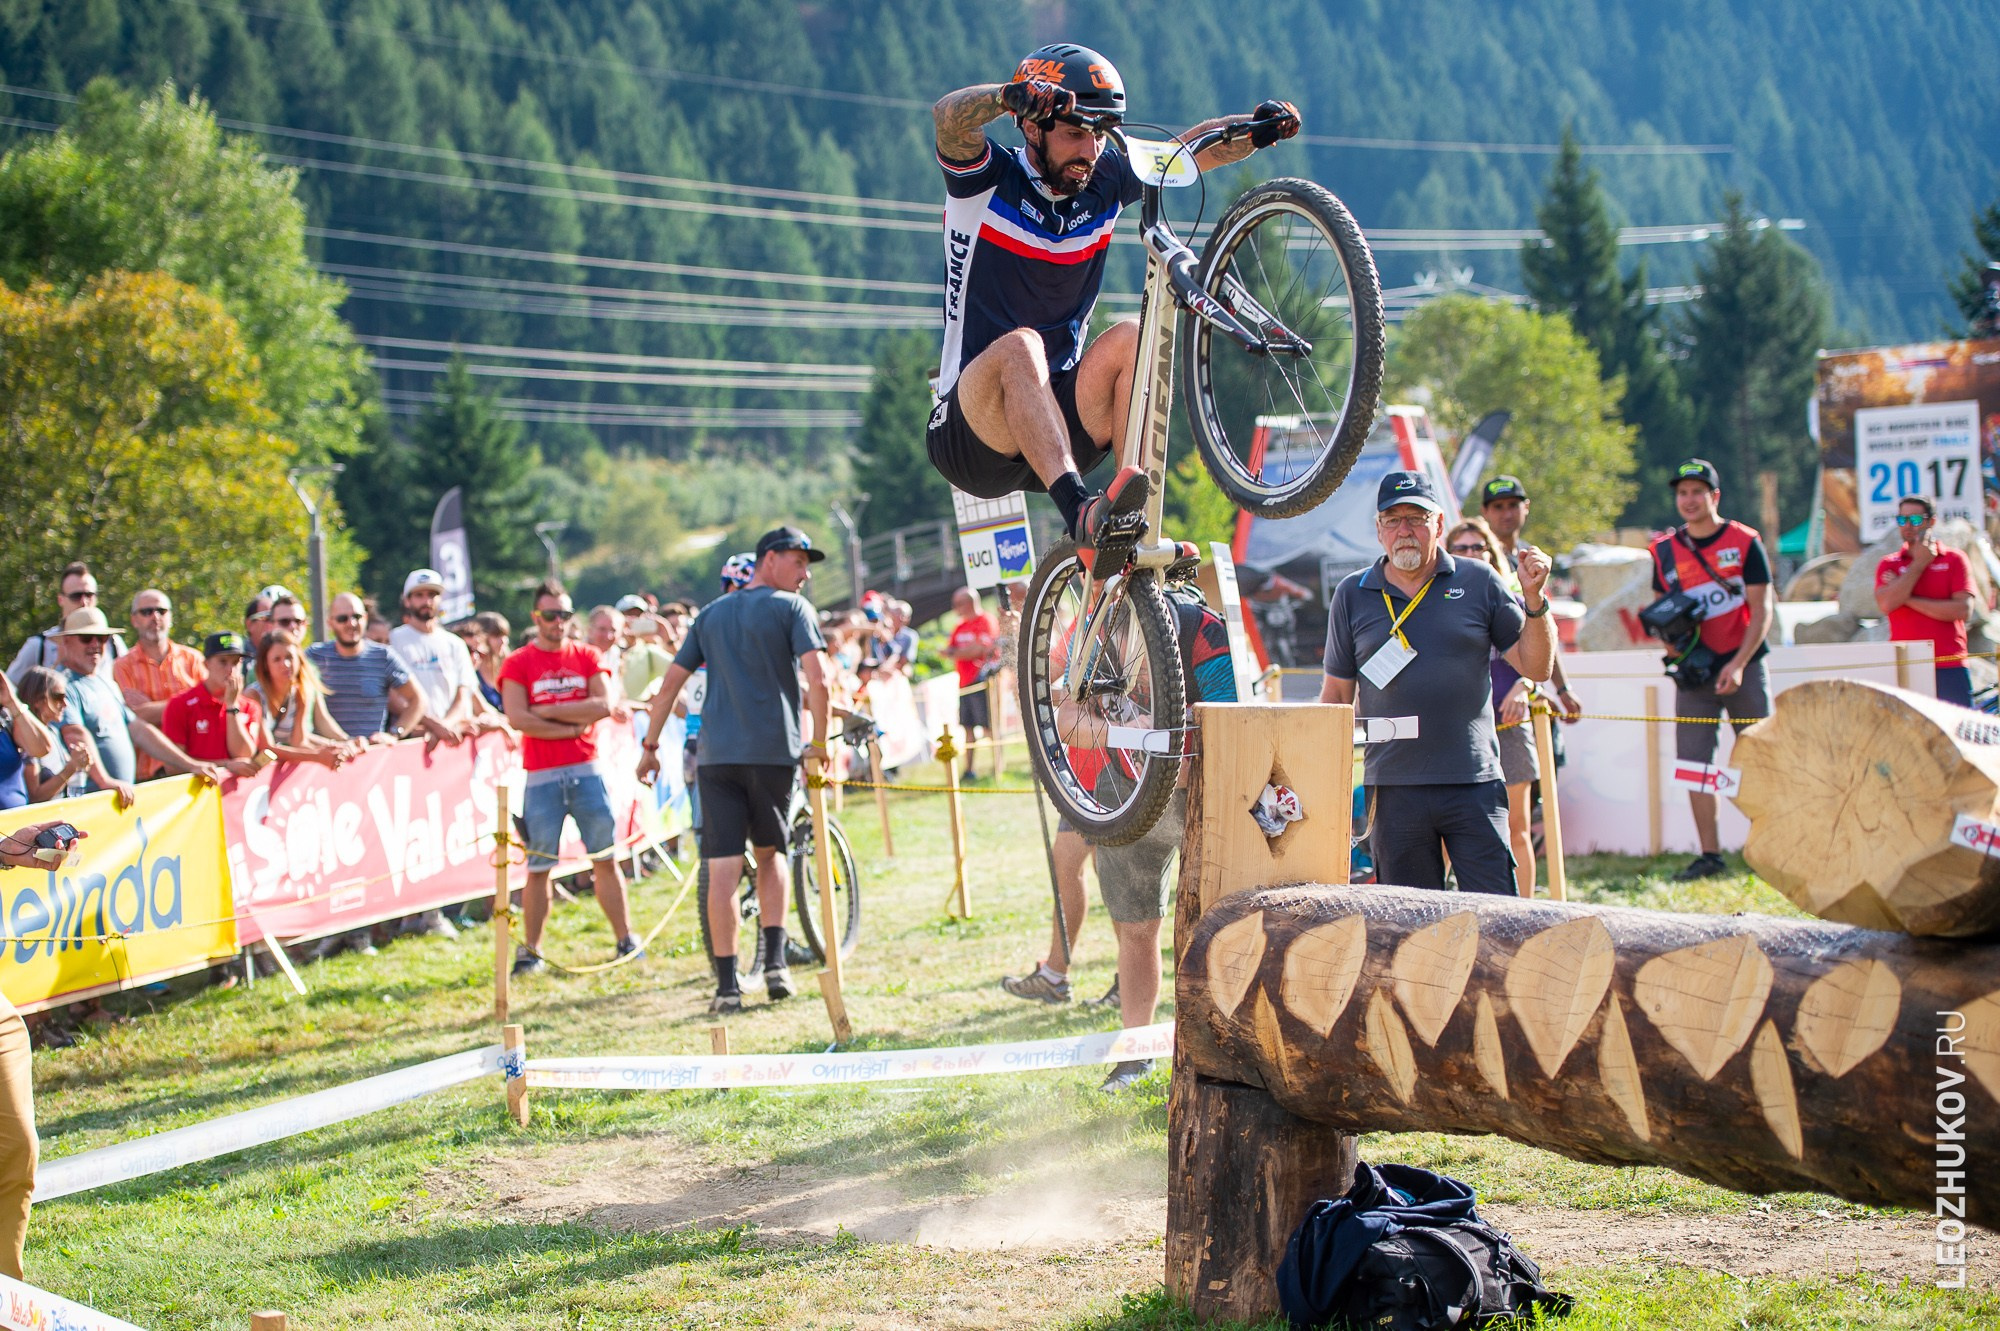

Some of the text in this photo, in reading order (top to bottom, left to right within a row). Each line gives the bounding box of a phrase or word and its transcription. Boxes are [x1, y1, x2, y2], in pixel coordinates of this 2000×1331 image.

[1014, 58, 1066, 79] TRIAL
[1154, 155, 1166, 173] 5
[1067, 210, 1092, 231] LOOK
[948, 228, 971, 321] FRANCE
[1151, 325, 1174, 460] CLEAN
[1869, 457, 1969, 502] 2017
[972, 549, 993, 568] UCI
[367, 774, 445, 897] Val
[0, 816, 183, 964] elinda
